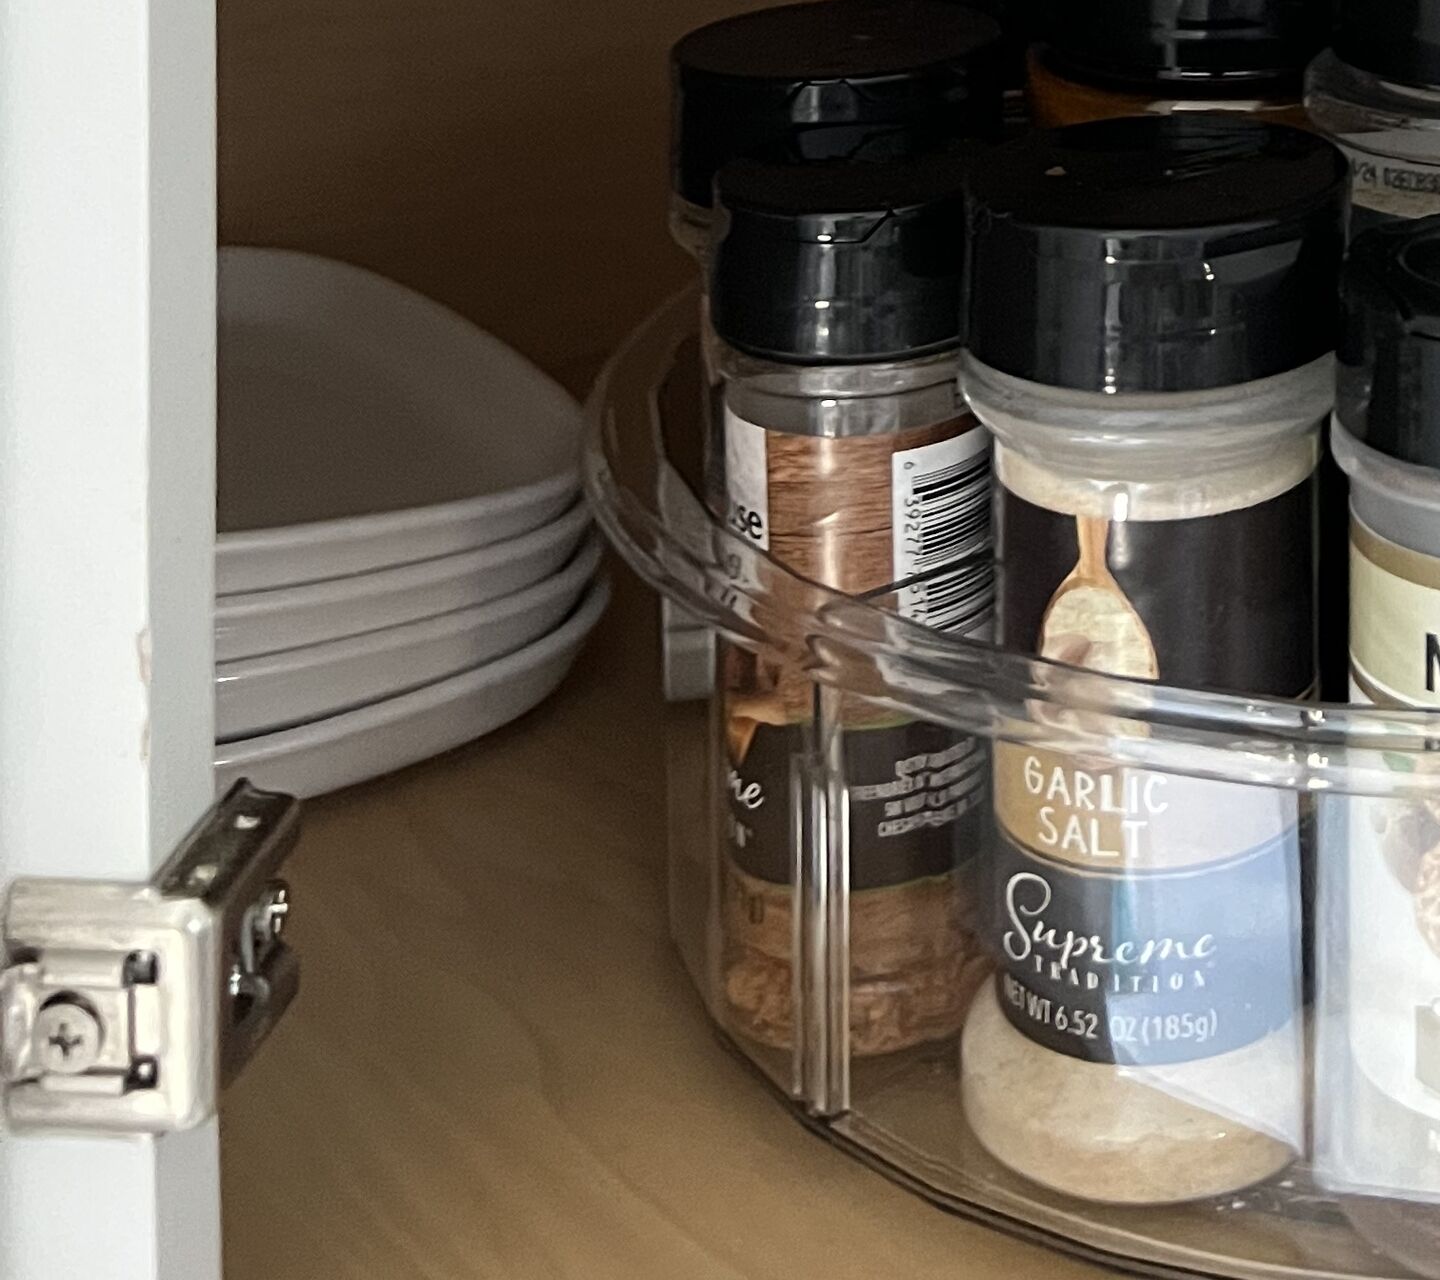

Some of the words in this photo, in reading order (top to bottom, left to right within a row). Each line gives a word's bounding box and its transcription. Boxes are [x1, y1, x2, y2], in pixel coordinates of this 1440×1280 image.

[1023, 755, 1170, 815] GARLIC
[1038, 805, 1148, 860] SALT
[1003, 871, 1218, 969] Supreme
[1032, 954, 1207, 994] TRADITION
[1054, 1005, 1100, 1040] 6.52
[1109, 1014, 1137, 1043] OZ
[1141, 1007, 1218, 1045] (185g)
